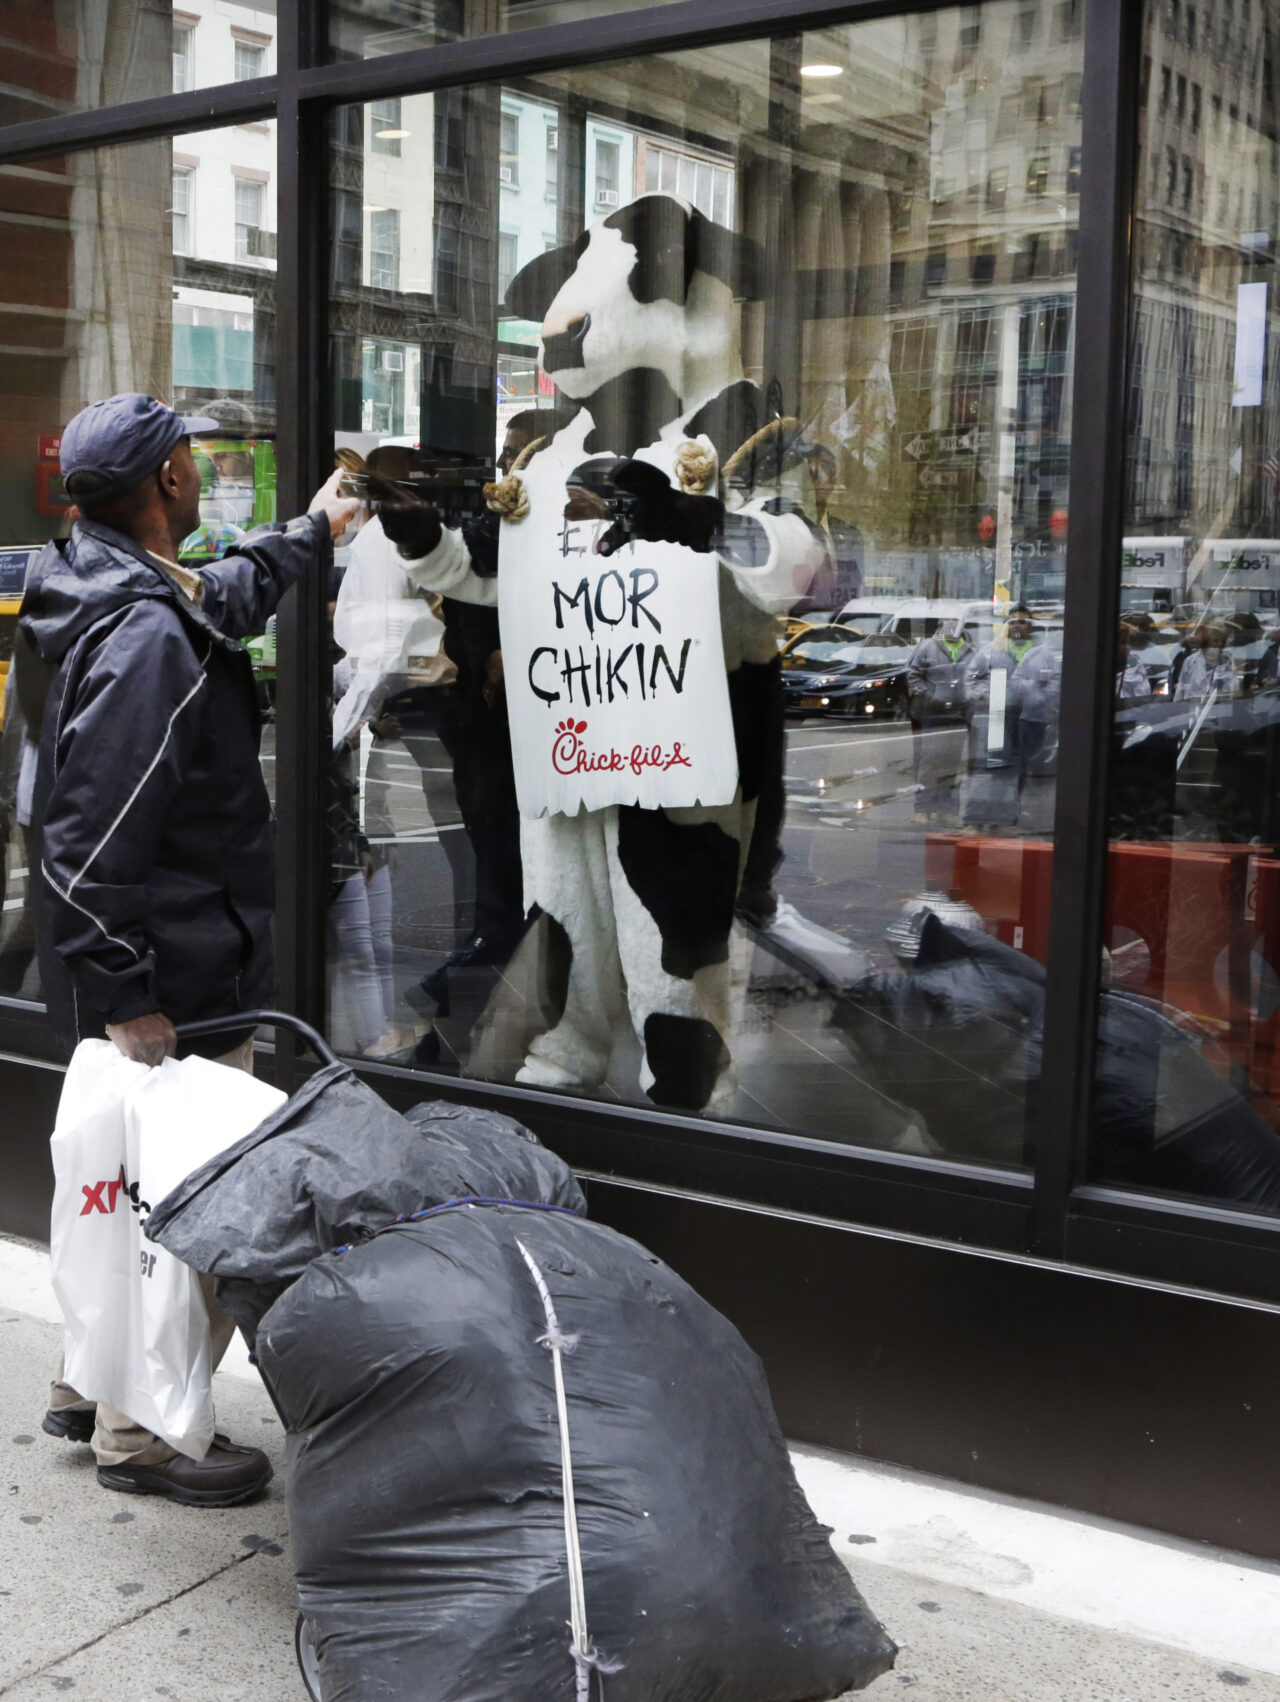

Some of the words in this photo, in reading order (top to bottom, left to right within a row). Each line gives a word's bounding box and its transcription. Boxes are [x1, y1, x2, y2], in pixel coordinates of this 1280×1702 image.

[551, 568, 661, 640] MOR
[528, 638, 692, 708] CHIKIN
[552, 718, 692, 775] Chick-fil-A
